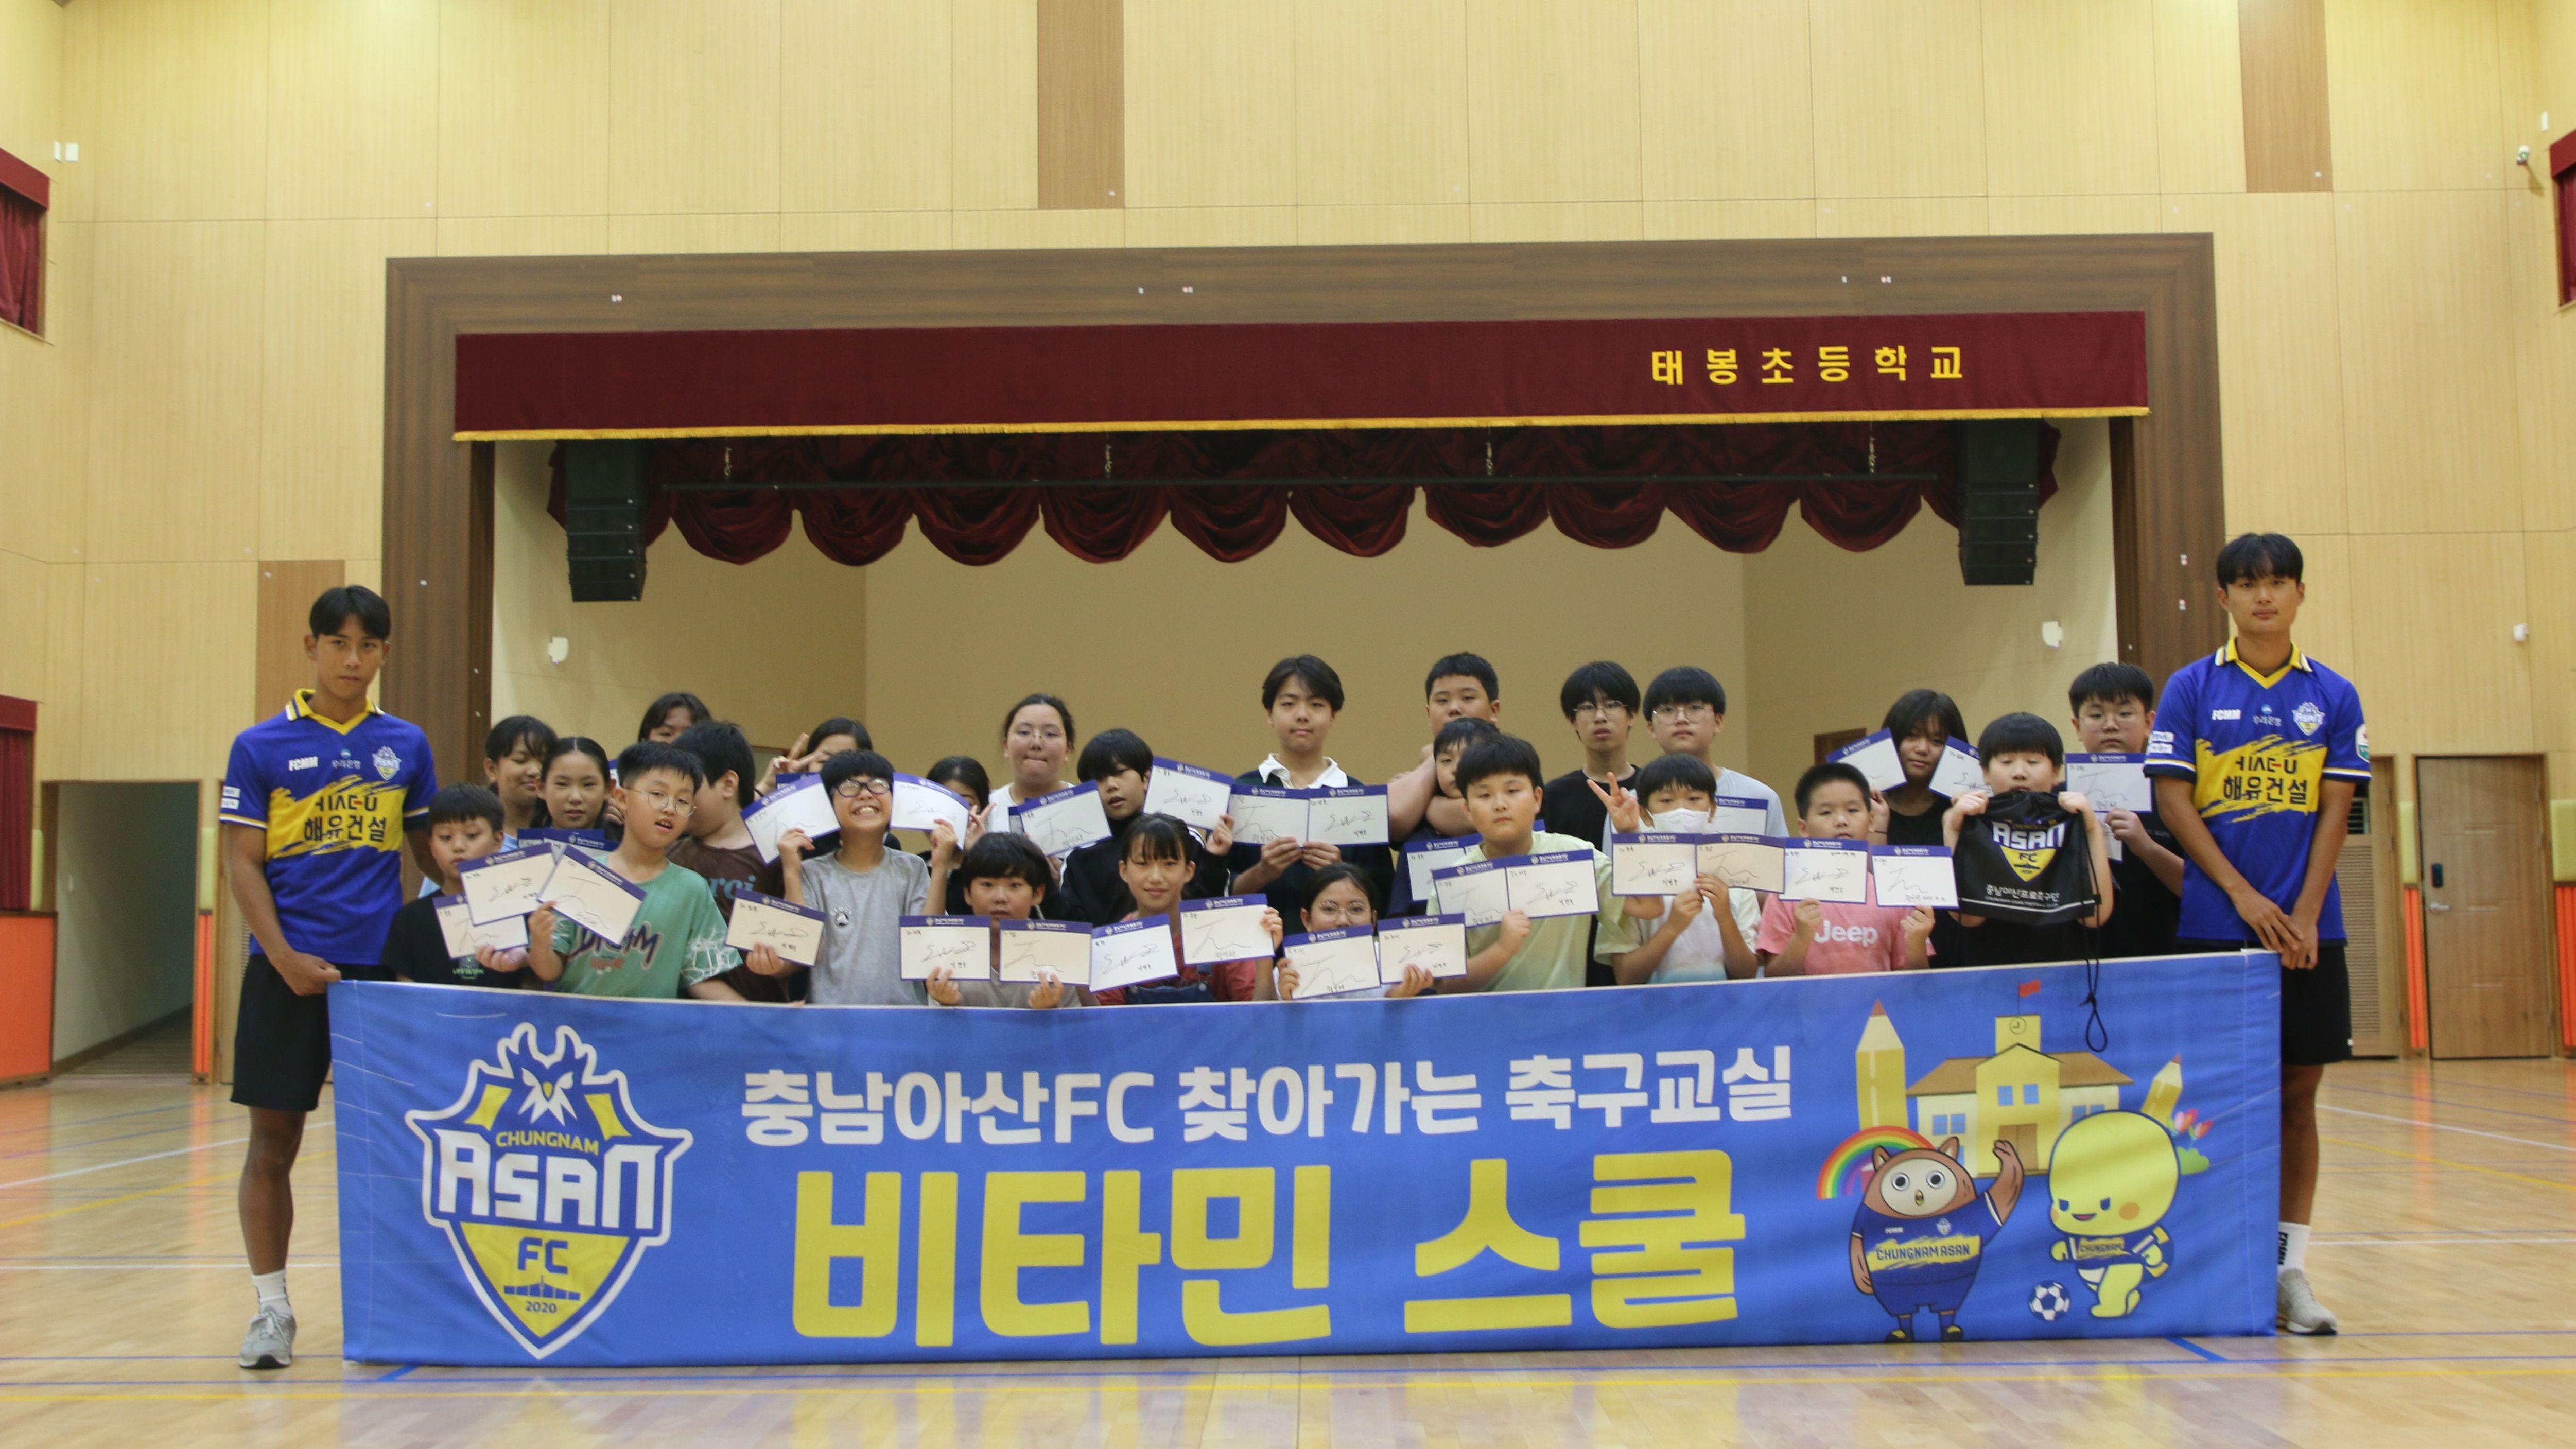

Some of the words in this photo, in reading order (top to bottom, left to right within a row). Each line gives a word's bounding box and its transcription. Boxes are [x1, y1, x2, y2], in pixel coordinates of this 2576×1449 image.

[1651, 345, 1963, 385] 태봉초등학교
[2223, 775, 2308, 805] 해유건설
[304, 815, 386, 843] 해유건설
[2019, 852, 2038, 862] FC
[1814, 919, 1878, 948] Jeep
[742, 1068, 1154, 1147] 충남아산FC
[1179, 1060, 1482, 1142] 찾아가는
[1505, 1045, 1792, 1130] 축구교실
[495, 1130, 599, 1156] CHUNGNAM
[433, 1128, 664, 1230] ASAN
[517, 1236, 569, 1275] FC
[792, 1164, 1332, 1347] 비타민
[1404, 1149, 1746, 1333] 스쿨
[1876, 1245, 1939, 1261] CHUNGNAM
[1941, 1244, 1971, 1256] ASAN
[526, 1290, 557, 1313] 2020
